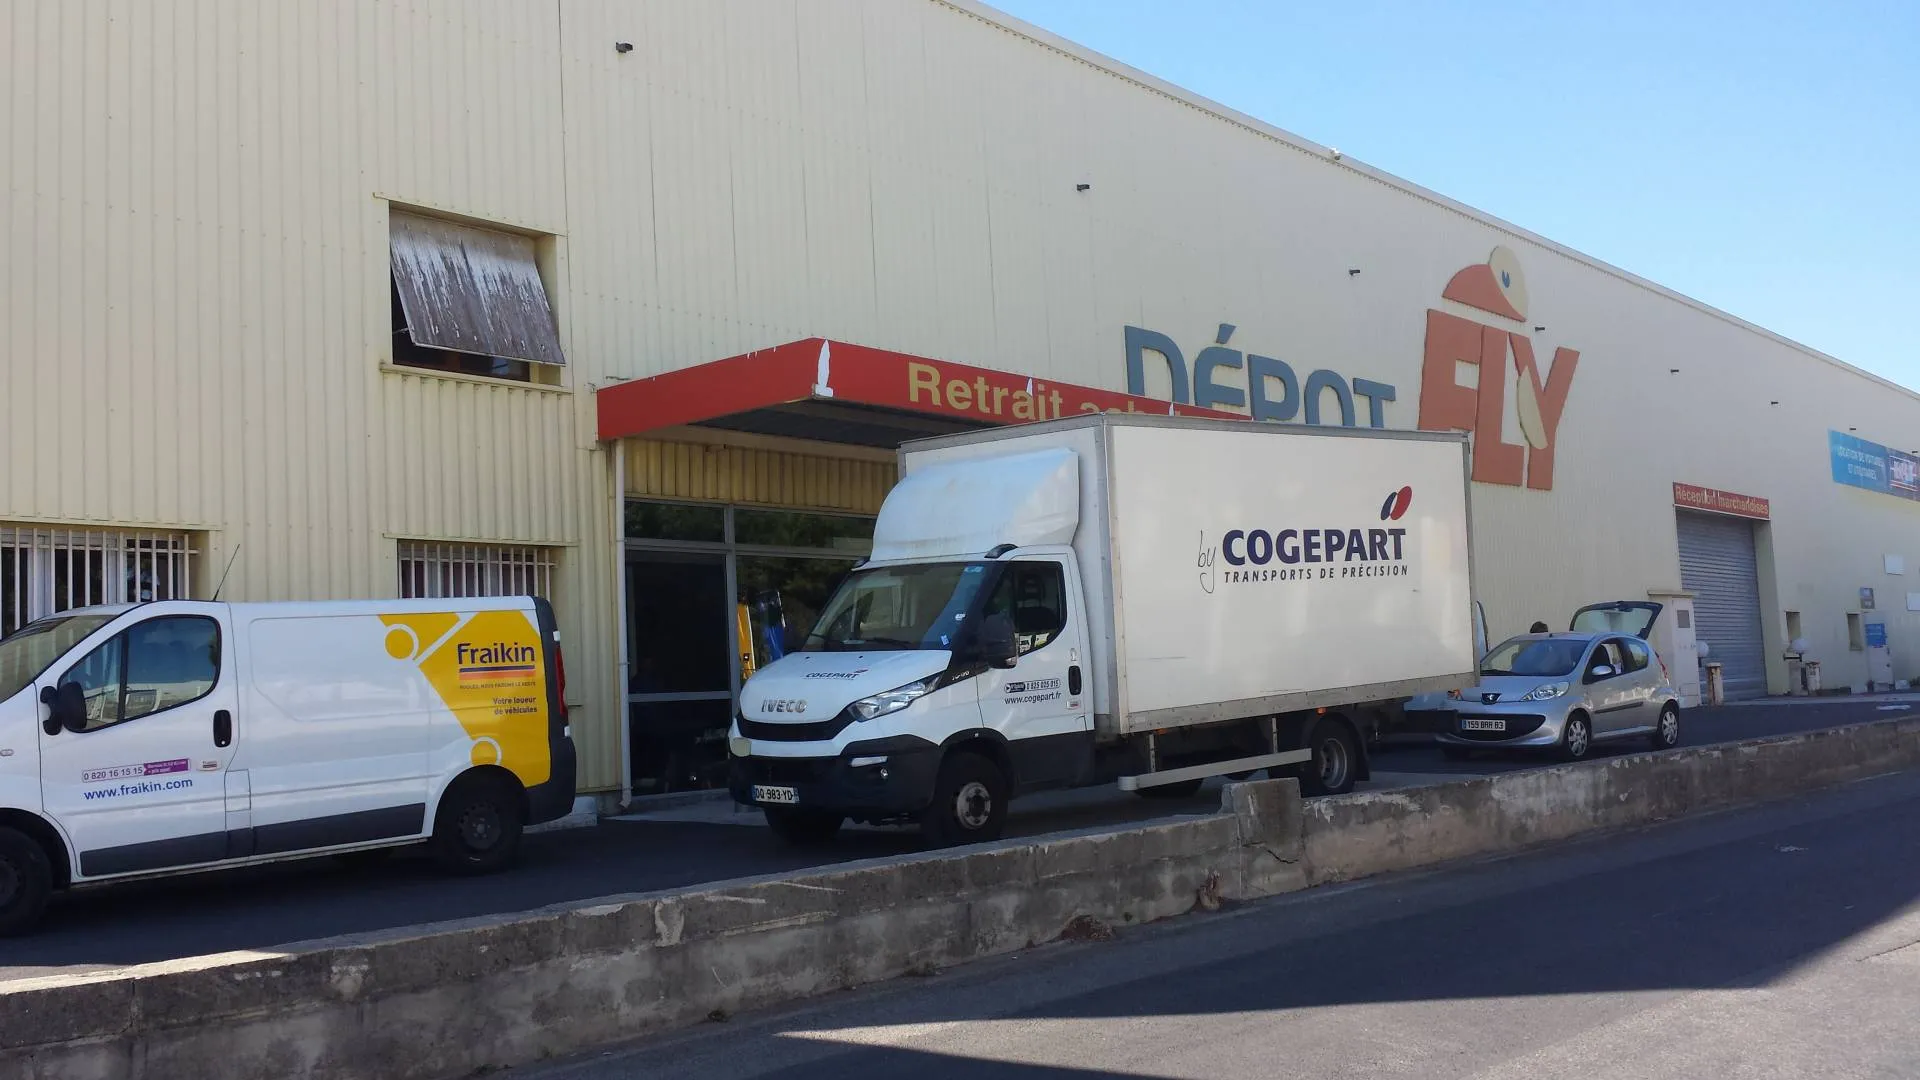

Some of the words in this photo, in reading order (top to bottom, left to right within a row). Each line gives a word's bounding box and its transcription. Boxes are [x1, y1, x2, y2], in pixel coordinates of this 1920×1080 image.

[908, 361, 1062, 420] Retrait
[1418, 309, 1580, 490] FLY
[1718, 496, 1768, 514] marchandises
[1197, 530, 1217, 594] by
[1222, 528, 1406, 566] COGEPART
[1224, 568, 1313, 583] TRANSPORTS
[1320, 567, 1334, 579] DE
[1342, 564, 1409, 578] PRÉCISION
[457, 642, 535, 664] Fraikin
[761, 699, 808, 714] IVECO
[1004, 691, 1062, 705] www.cogepart.fr
[505, 707, 538, 715] véhicules
[1468, 721, 1479, 729] 159
[83, 773, 90, 781] 0
[91, 771, 106, 780] 820
[109, 769, 119, 778] 16
[121, 768, 131, 777] 15
[133, 767, 143, 775] 15
[83, 777, 193, 801] www.fraikin.com
